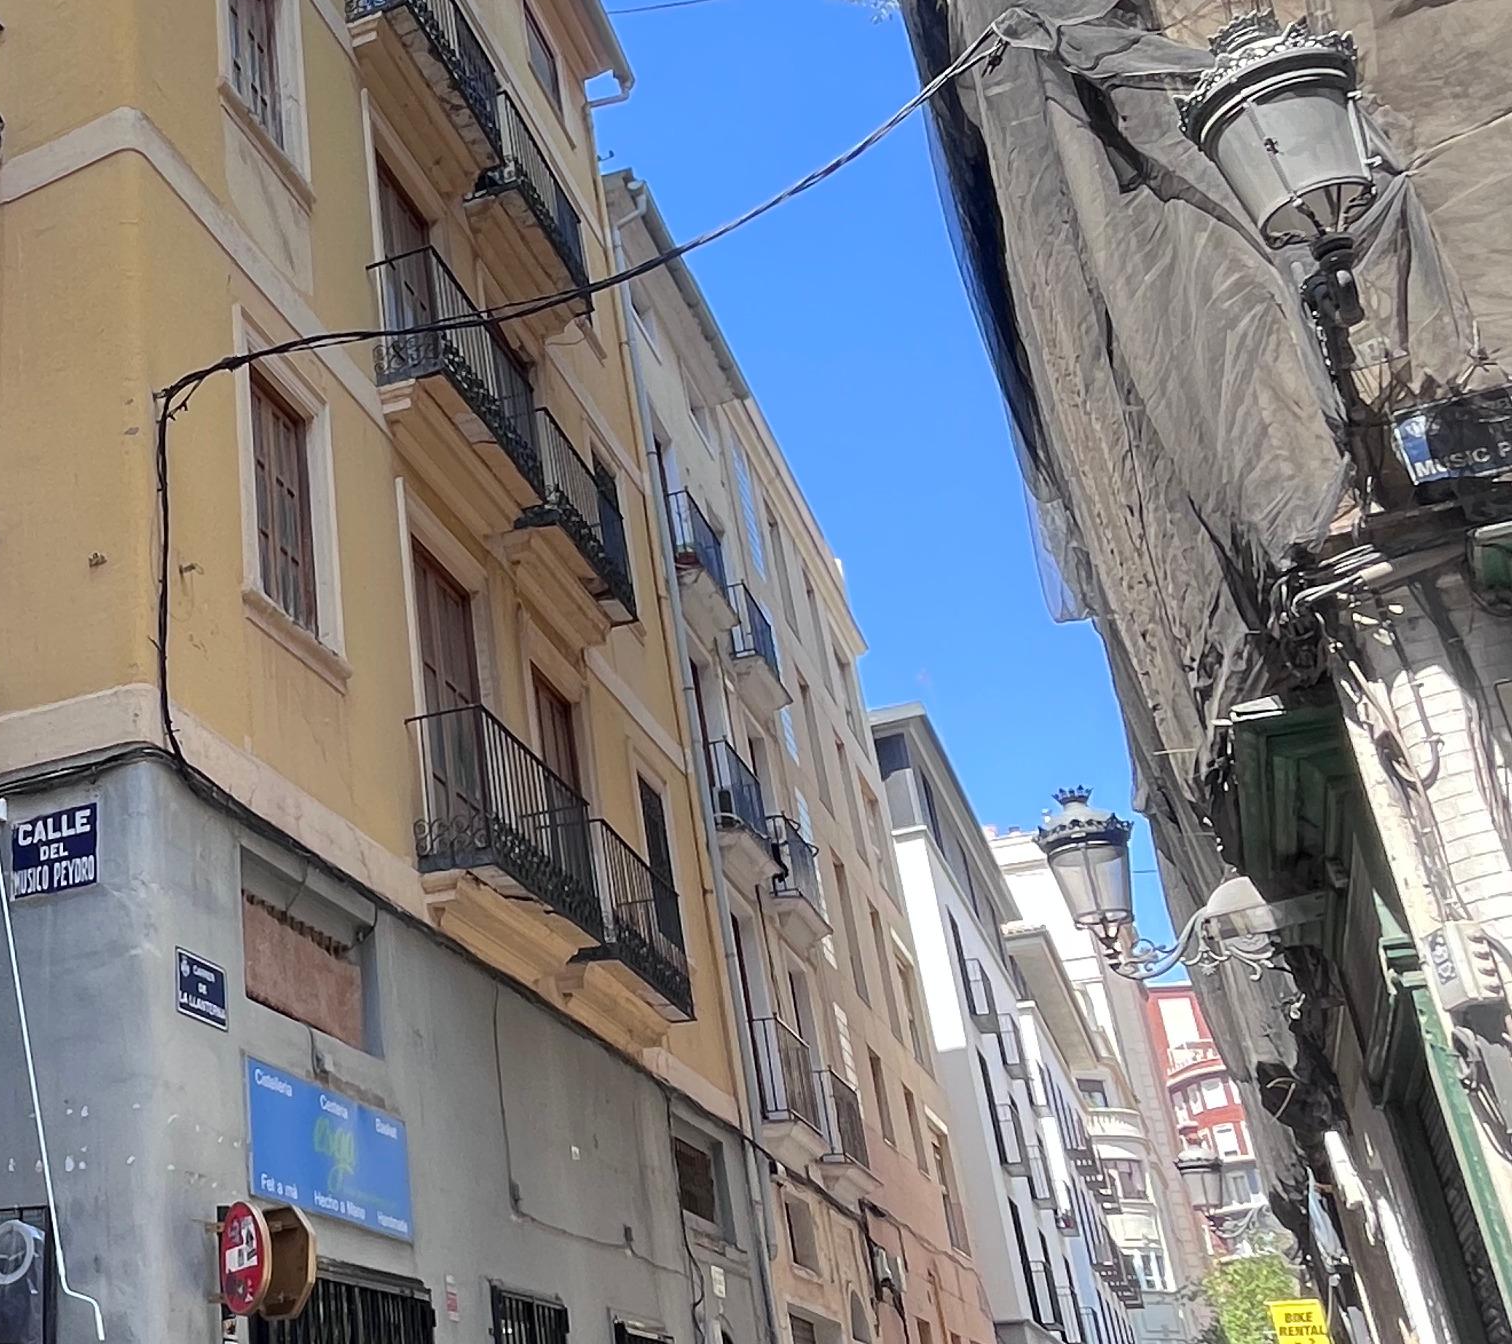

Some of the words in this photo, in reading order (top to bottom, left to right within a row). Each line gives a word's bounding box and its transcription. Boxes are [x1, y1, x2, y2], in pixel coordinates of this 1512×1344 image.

[18, 809, 91, 846] CALLE
[39, 842, 68, 861] DEL
[1284, 1311, 1314, 1323] BIKE
[1279, 1325, 1328, 1336] RENTAL
